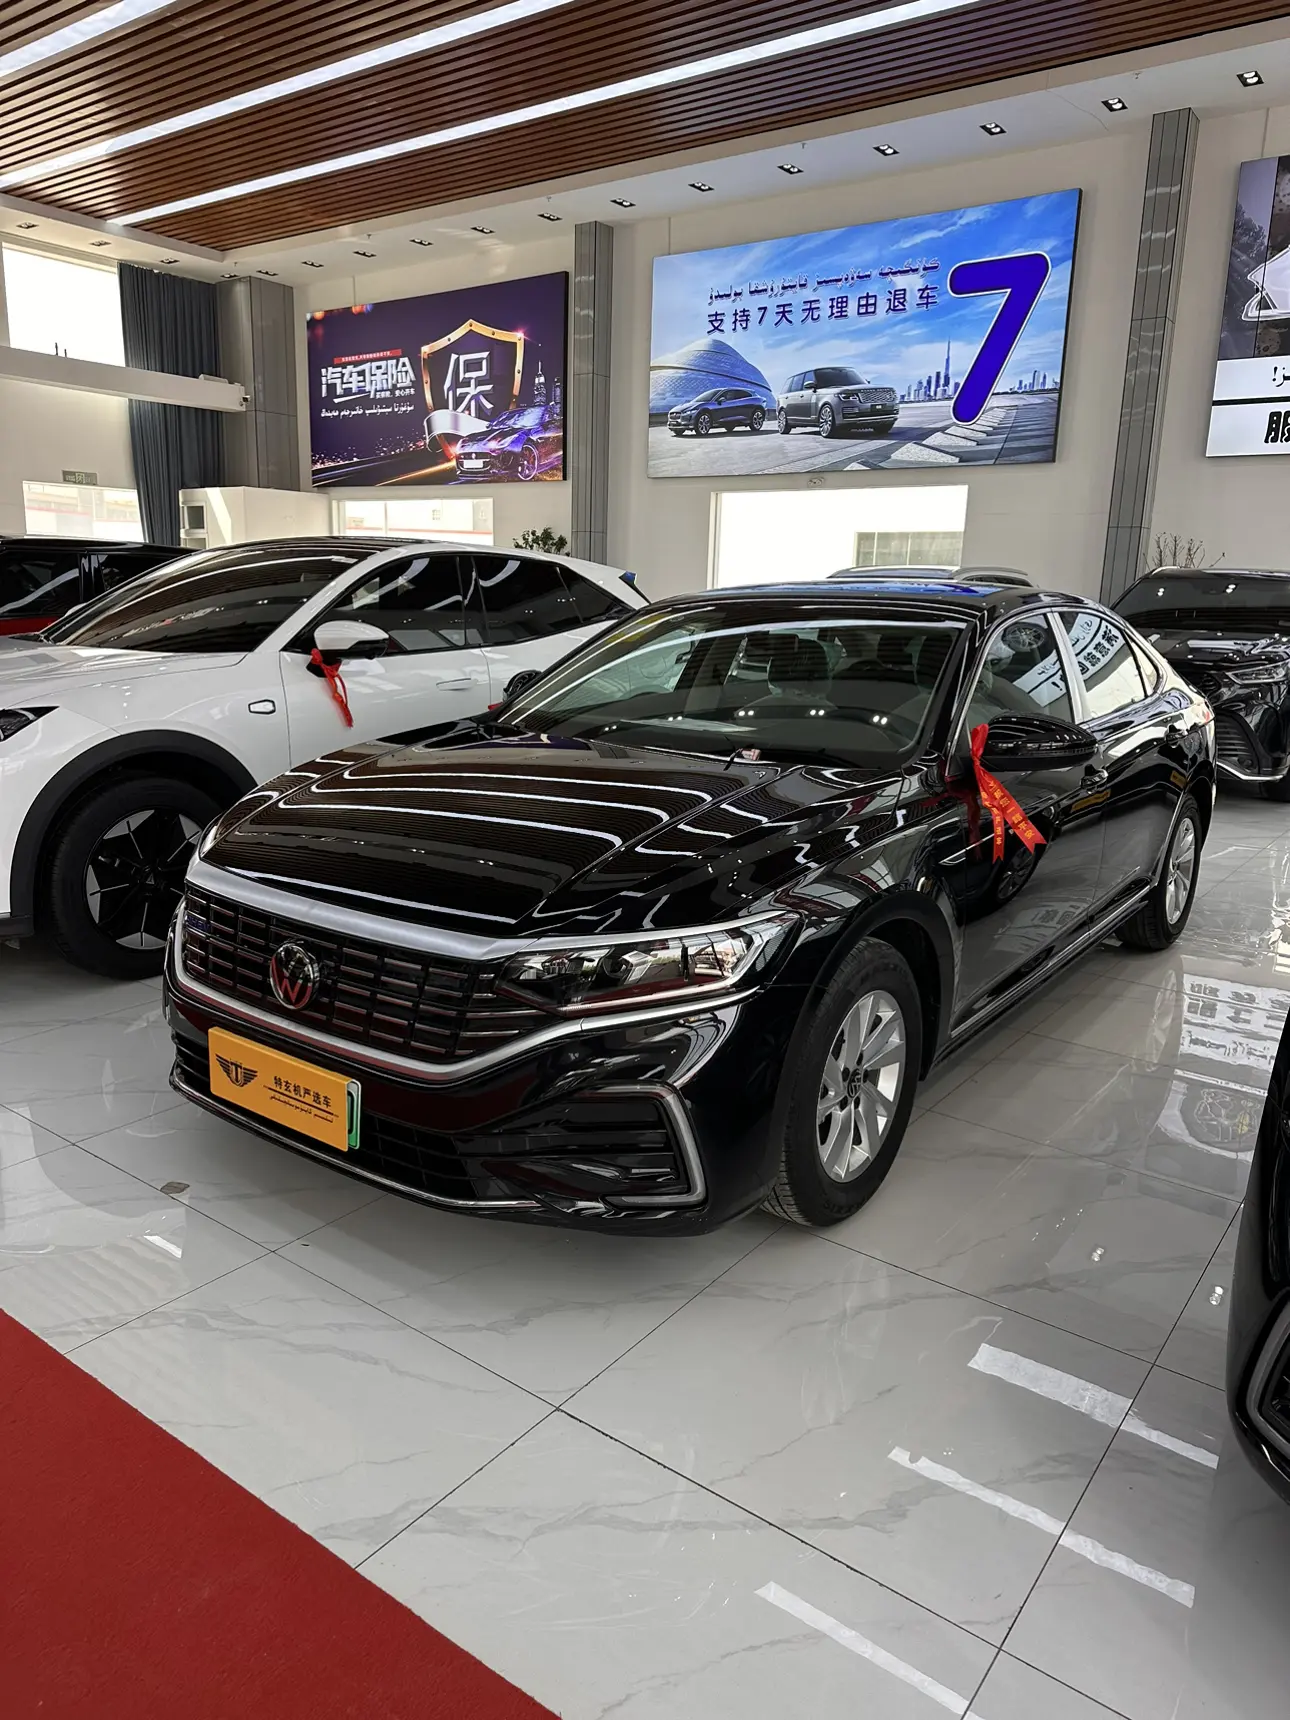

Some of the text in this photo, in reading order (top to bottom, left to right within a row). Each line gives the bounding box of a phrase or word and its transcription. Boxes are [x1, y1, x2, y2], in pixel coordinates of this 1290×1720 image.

[707, 284, 939, 335] 支持7天无理由退车
[947, 252, 1051, 425] 7
[321, 357, 416, 403] 汽车保险
[443, 351, 494, 417] 保
